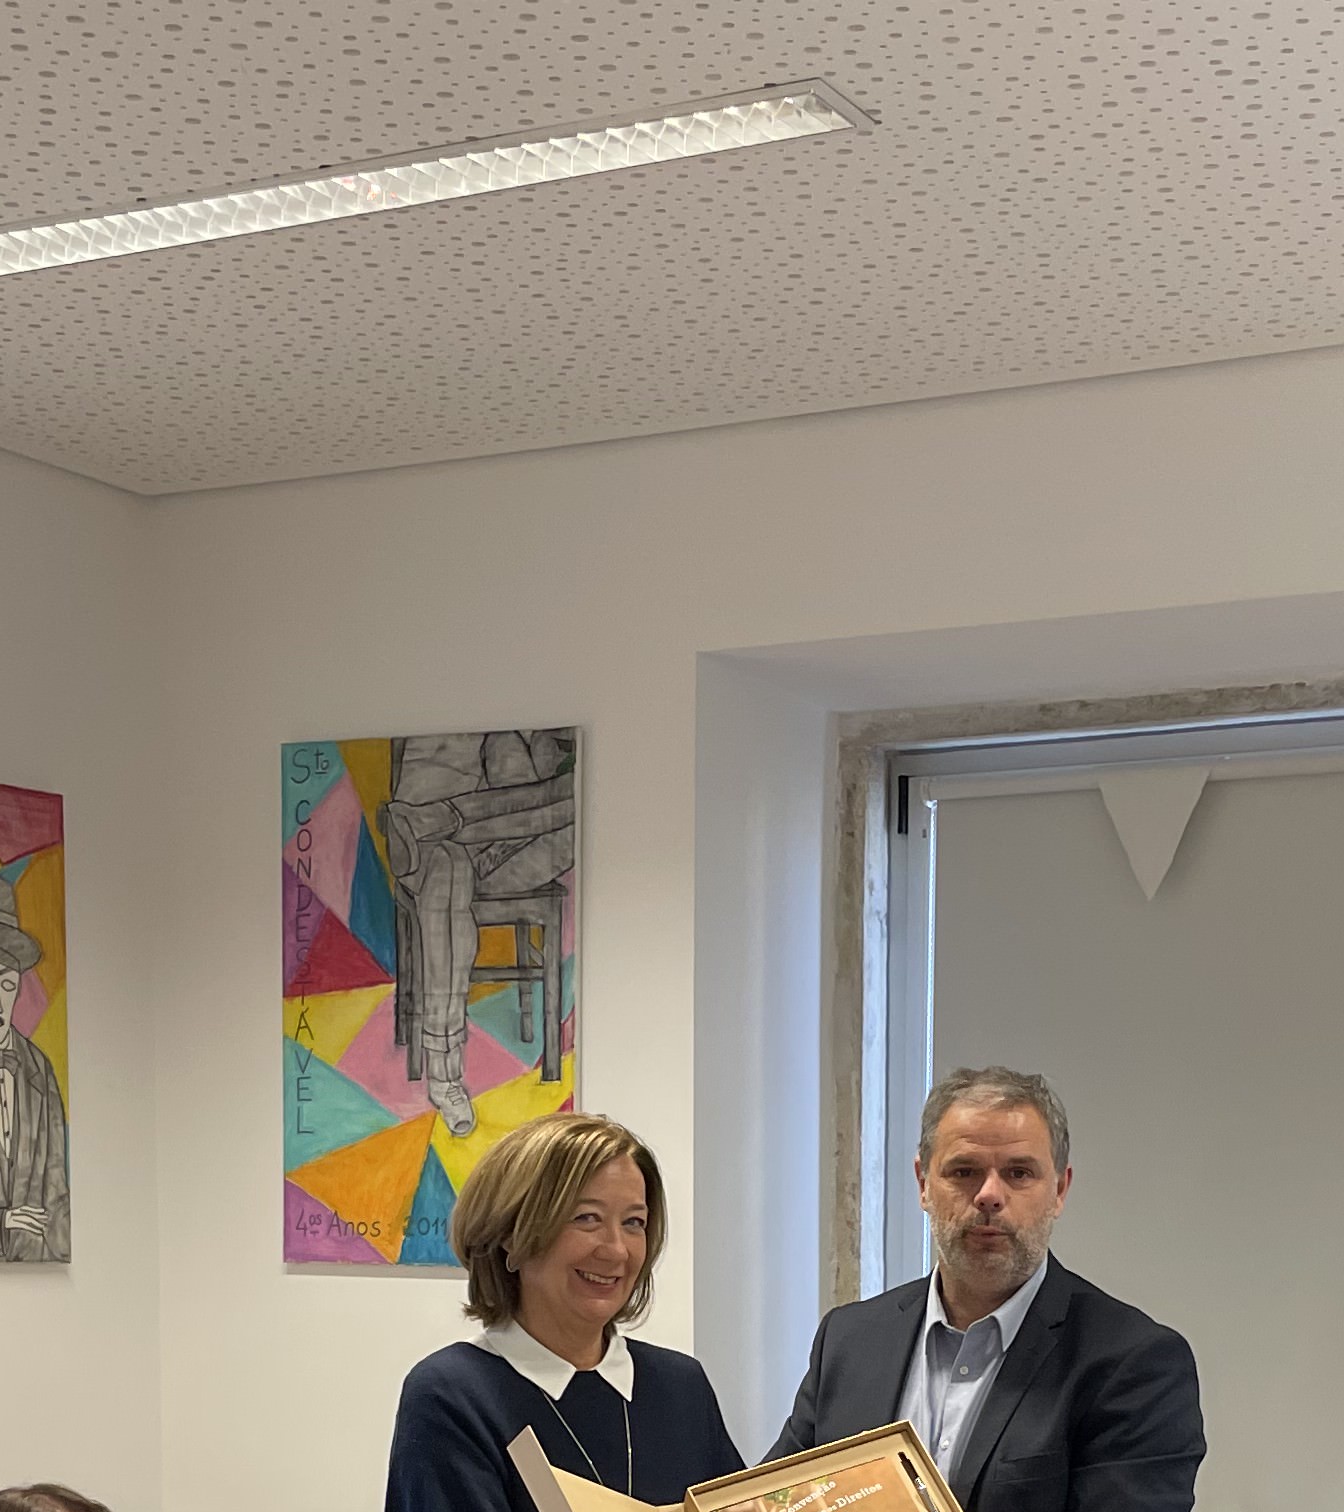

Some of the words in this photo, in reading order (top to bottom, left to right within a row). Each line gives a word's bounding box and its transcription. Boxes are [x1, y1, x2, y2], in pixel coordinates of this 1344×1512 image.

[294, 799, 315, 1135] CONDESTÁVEL
[326, 1209, 382, 1238] Anos
[836, 1482, 883, 1509] Direitos
